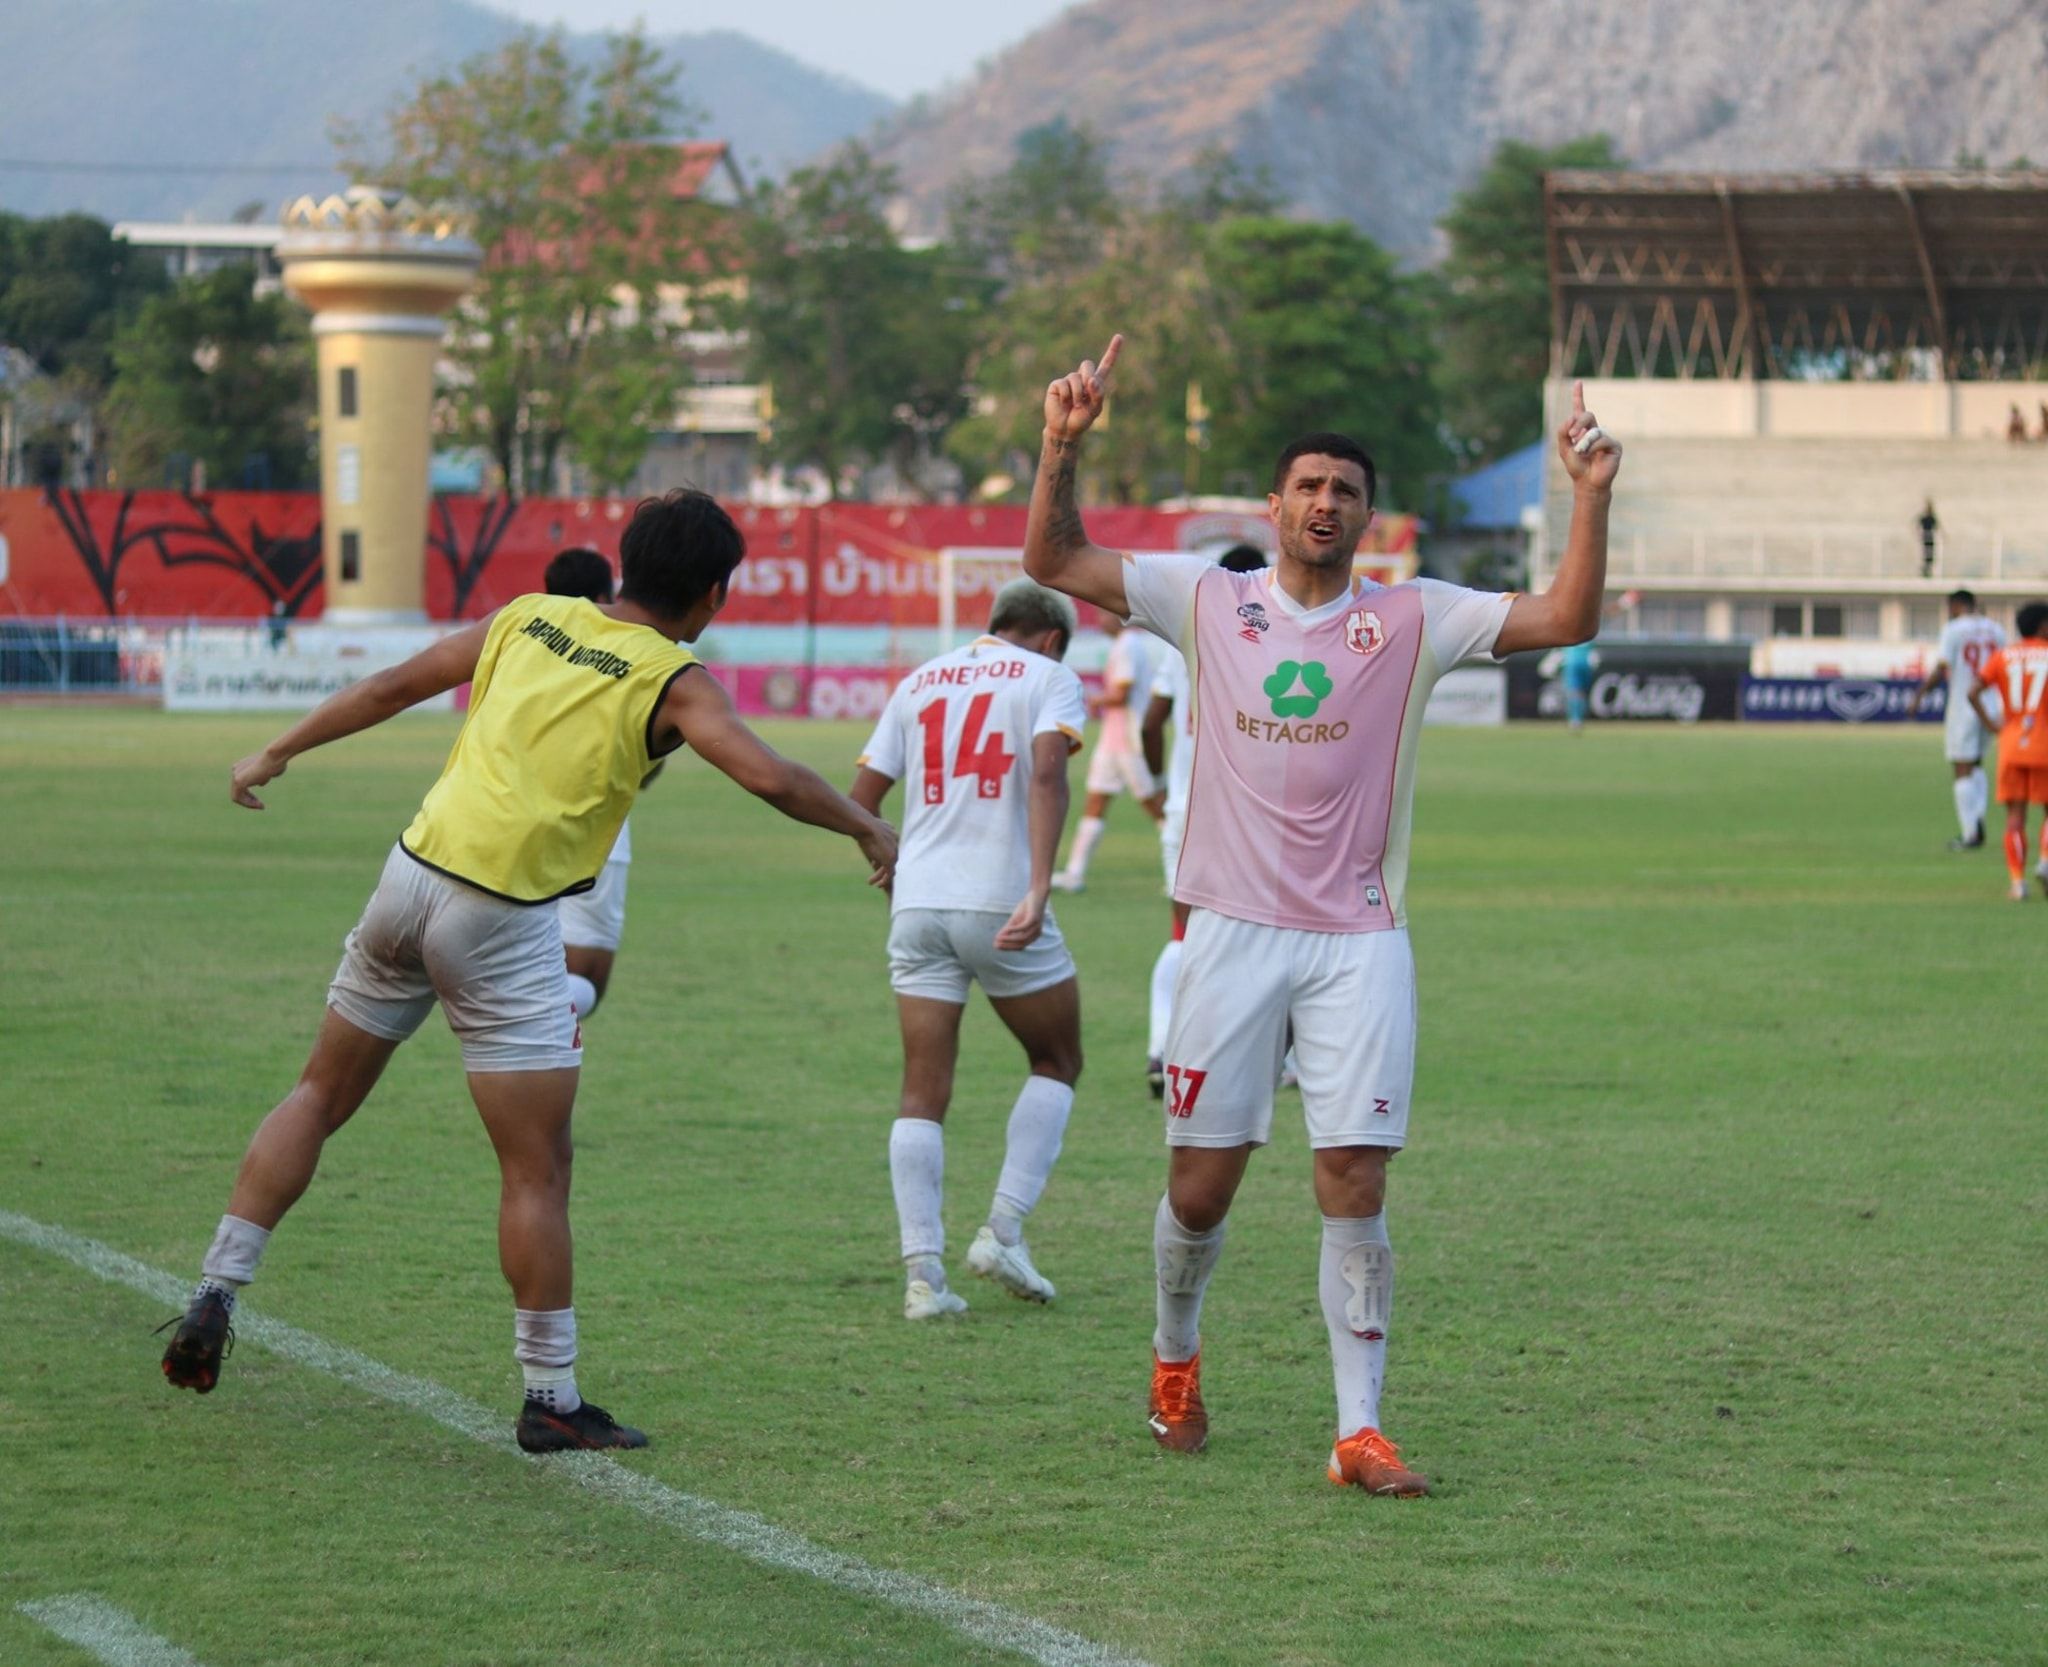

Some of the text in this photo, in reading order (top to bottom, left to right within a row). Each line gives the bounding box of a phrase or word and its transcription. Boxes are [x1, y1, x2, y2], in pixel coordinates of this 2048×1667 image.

[910, 660, 1026, 694] JANEPOB
[1590, 672, 1704, 723] Chang
[2006, 659, 2048, 711] 17
[918, 692, 1016, 805] 14
[1236, 710, 1349, 743] BETAGRO
[1166, 1063, 1208, 1118] 37
